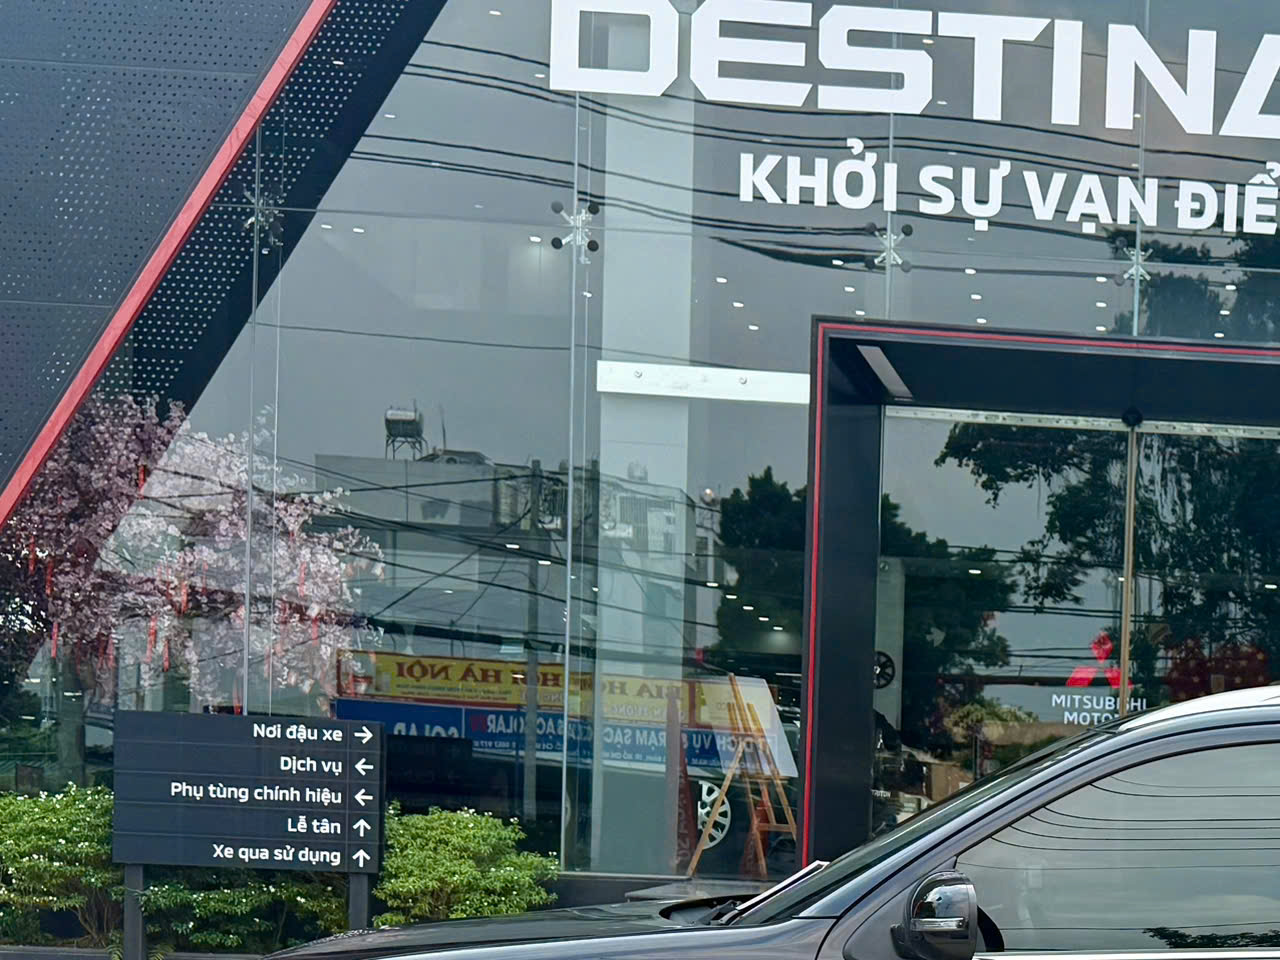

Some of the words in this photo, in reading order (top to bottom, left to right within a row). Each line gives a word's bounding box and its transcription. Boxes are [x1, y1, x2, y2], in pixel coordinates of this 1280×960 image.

[739, 138, 898, 212] KHỞI
[918, 159, 1011, 231] SỰ
[1022, 169, 1159, 234] VẠN
[1064, 711, 1120, 725] MOTO
[253, 723, 281, 738] Nơi
[286, 724, 318, 743] đậu
[322, 728, 343, 741] xe
[280, 756, 317, 774] Dịch
[321, 760, 342, 776] vụ
[171, 782, 204, 800] Phụ
[208, 782, 249, 802] tùng
[254, 785, 301, 802] chính
[306, 787, 342, 806] hiệu
[288, 816, 308, 833] Lễ
[312, 818, 341, 834] tân
[213, 844, 234, 859] Xe
[238, 847, 269, 862] qua
[273, 845, 295, 861] sử
[298, 847, 341, 866] dụng
